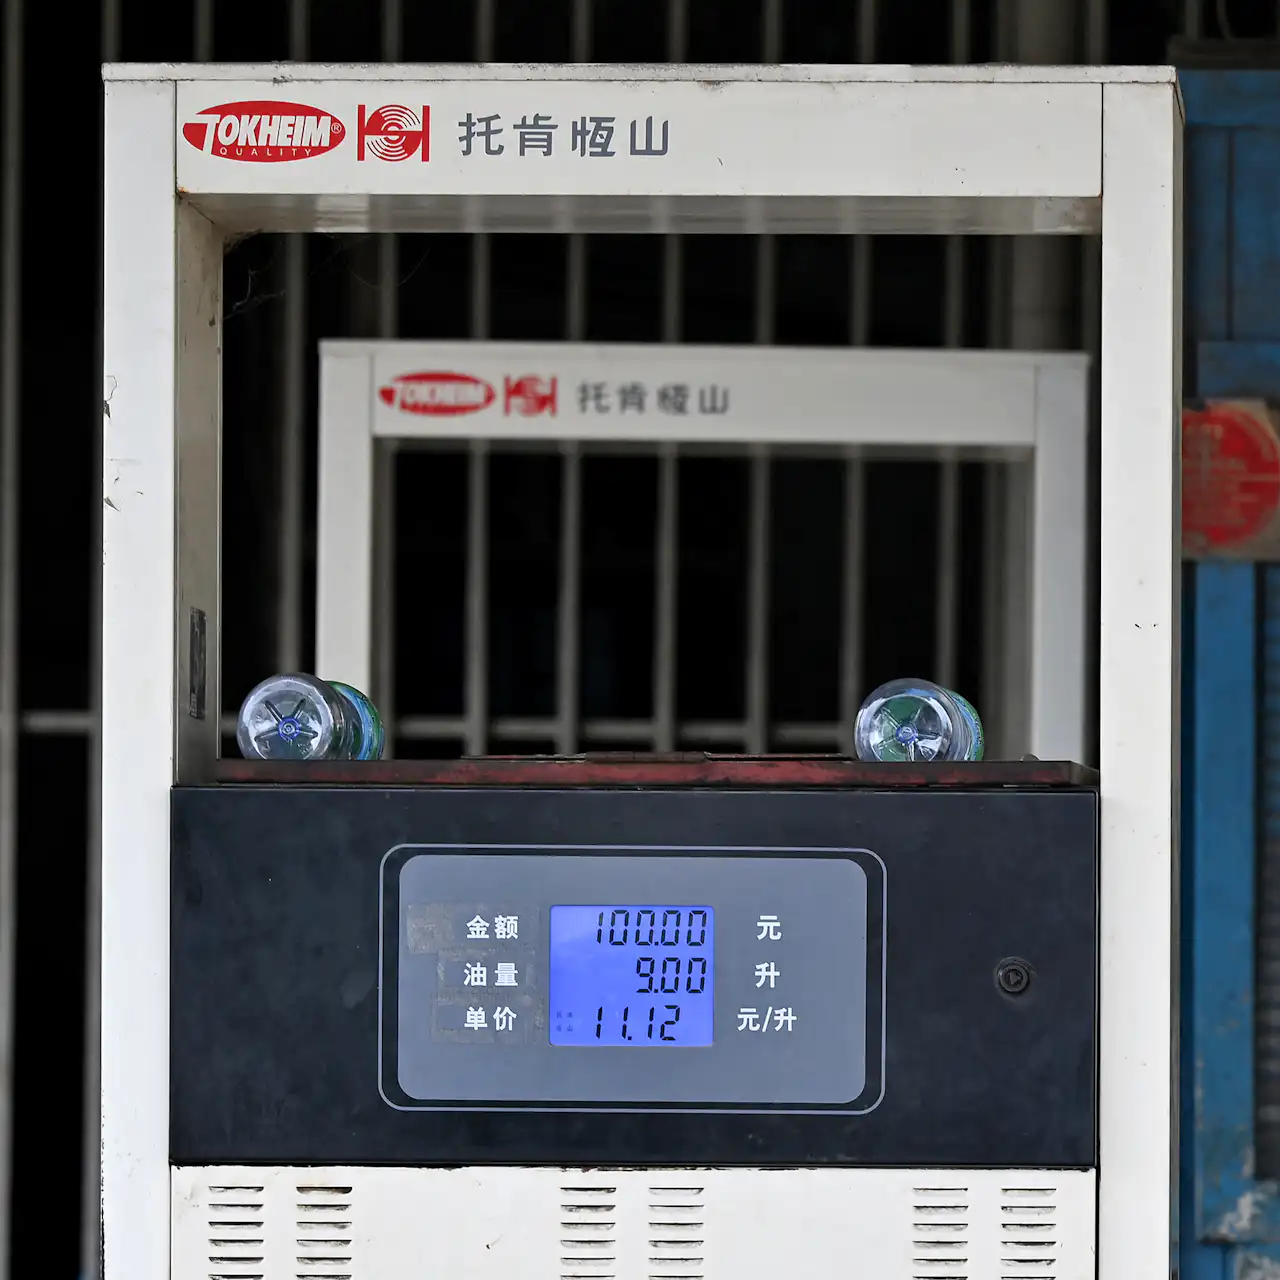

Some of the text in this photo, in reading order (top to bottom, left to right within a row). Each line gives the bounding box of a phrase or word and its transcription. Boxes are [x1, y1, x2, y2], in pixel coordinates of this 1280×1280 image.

[219, 147, 312, 157] QUALITY
[466, 914, 519, 939] 金额
[597, 909, 707, 947] 100.00
[756, 915, 782, 940] 元
[463, 962, 519, 987] 油量
[636, 957, 707, 994] 9.00
[754, 961, 781, 988] 升
[464, 1006, 517, 1031] 单价
[596, 1005, 681, 1041] 11.12
[737, 1006, 797, 1033] 元/升
